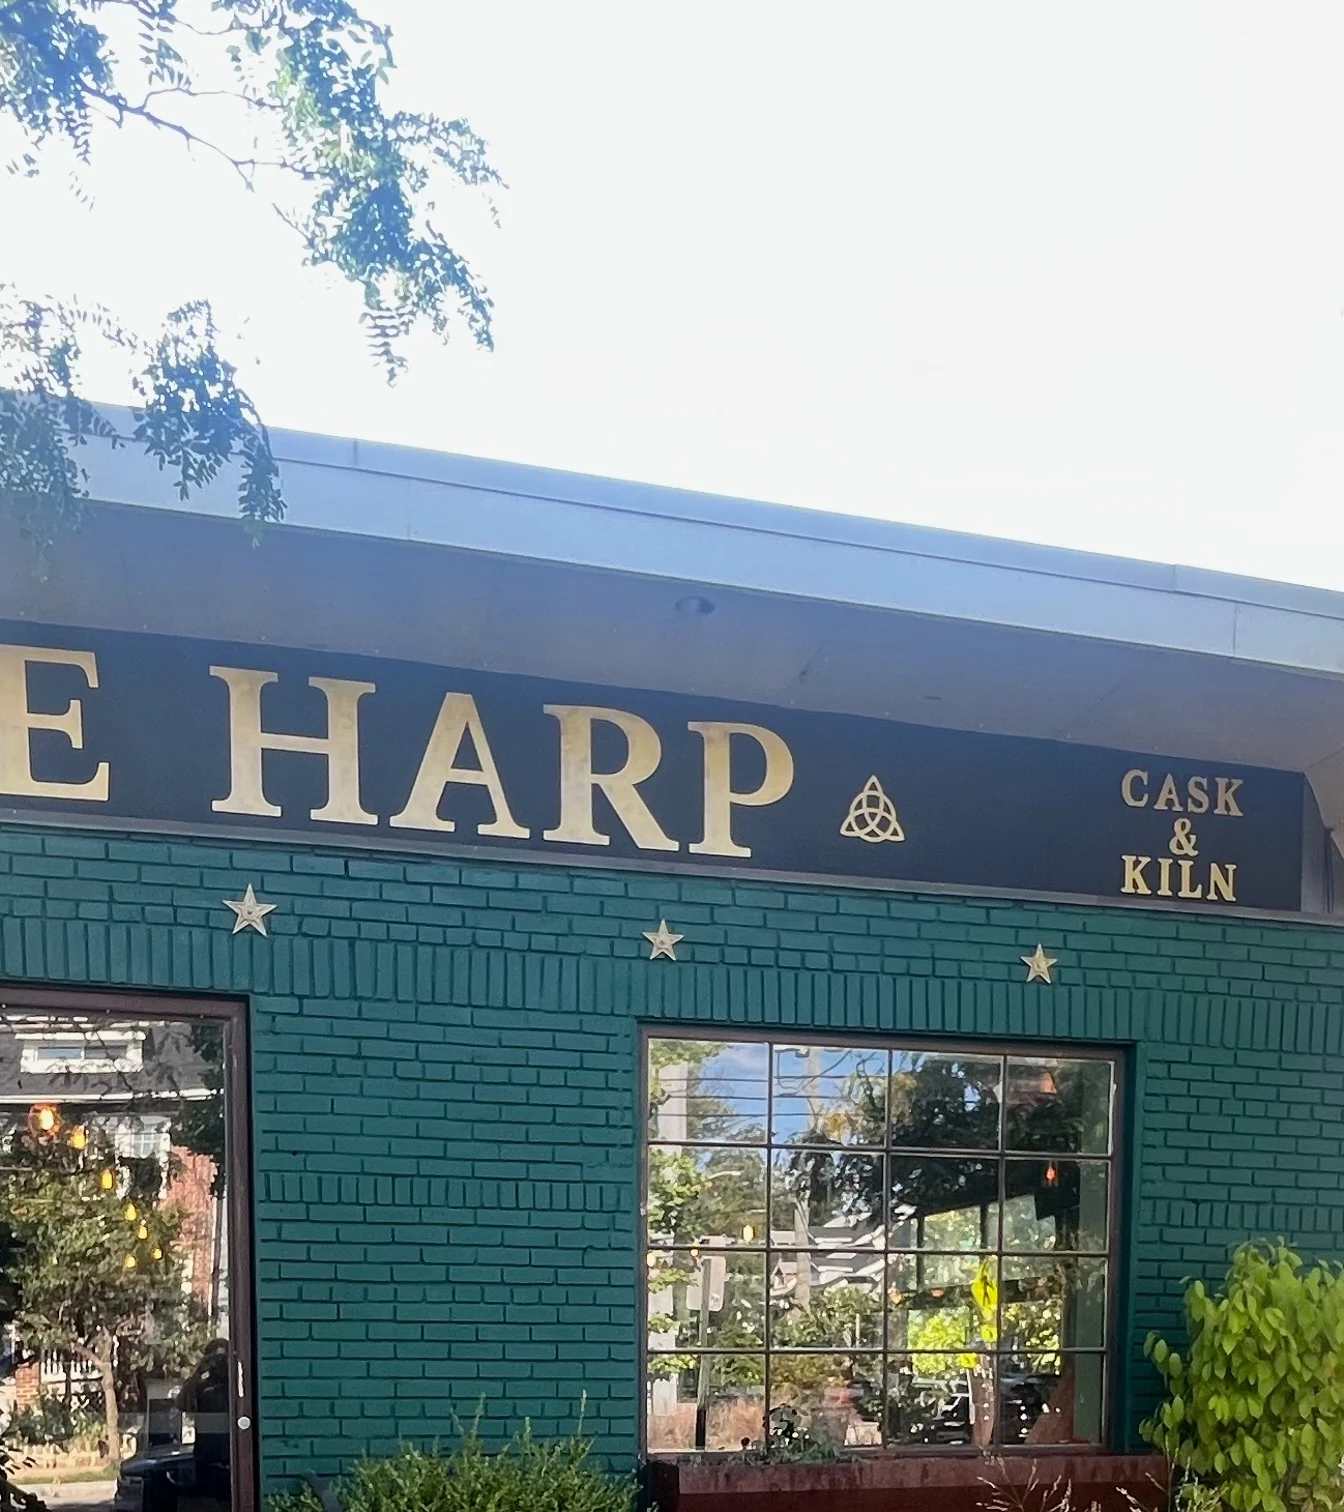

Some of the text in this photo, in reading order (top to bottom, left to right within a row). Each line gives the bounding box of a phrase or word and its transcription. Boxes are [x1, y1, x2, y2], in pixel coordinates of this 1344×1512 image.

[209, 665, 795, 858] HARP
[1121, 768, 1244, 817] CASK
[1169, 817, 1199, 857] &
[1120, 855, 1238, 902] KILN
